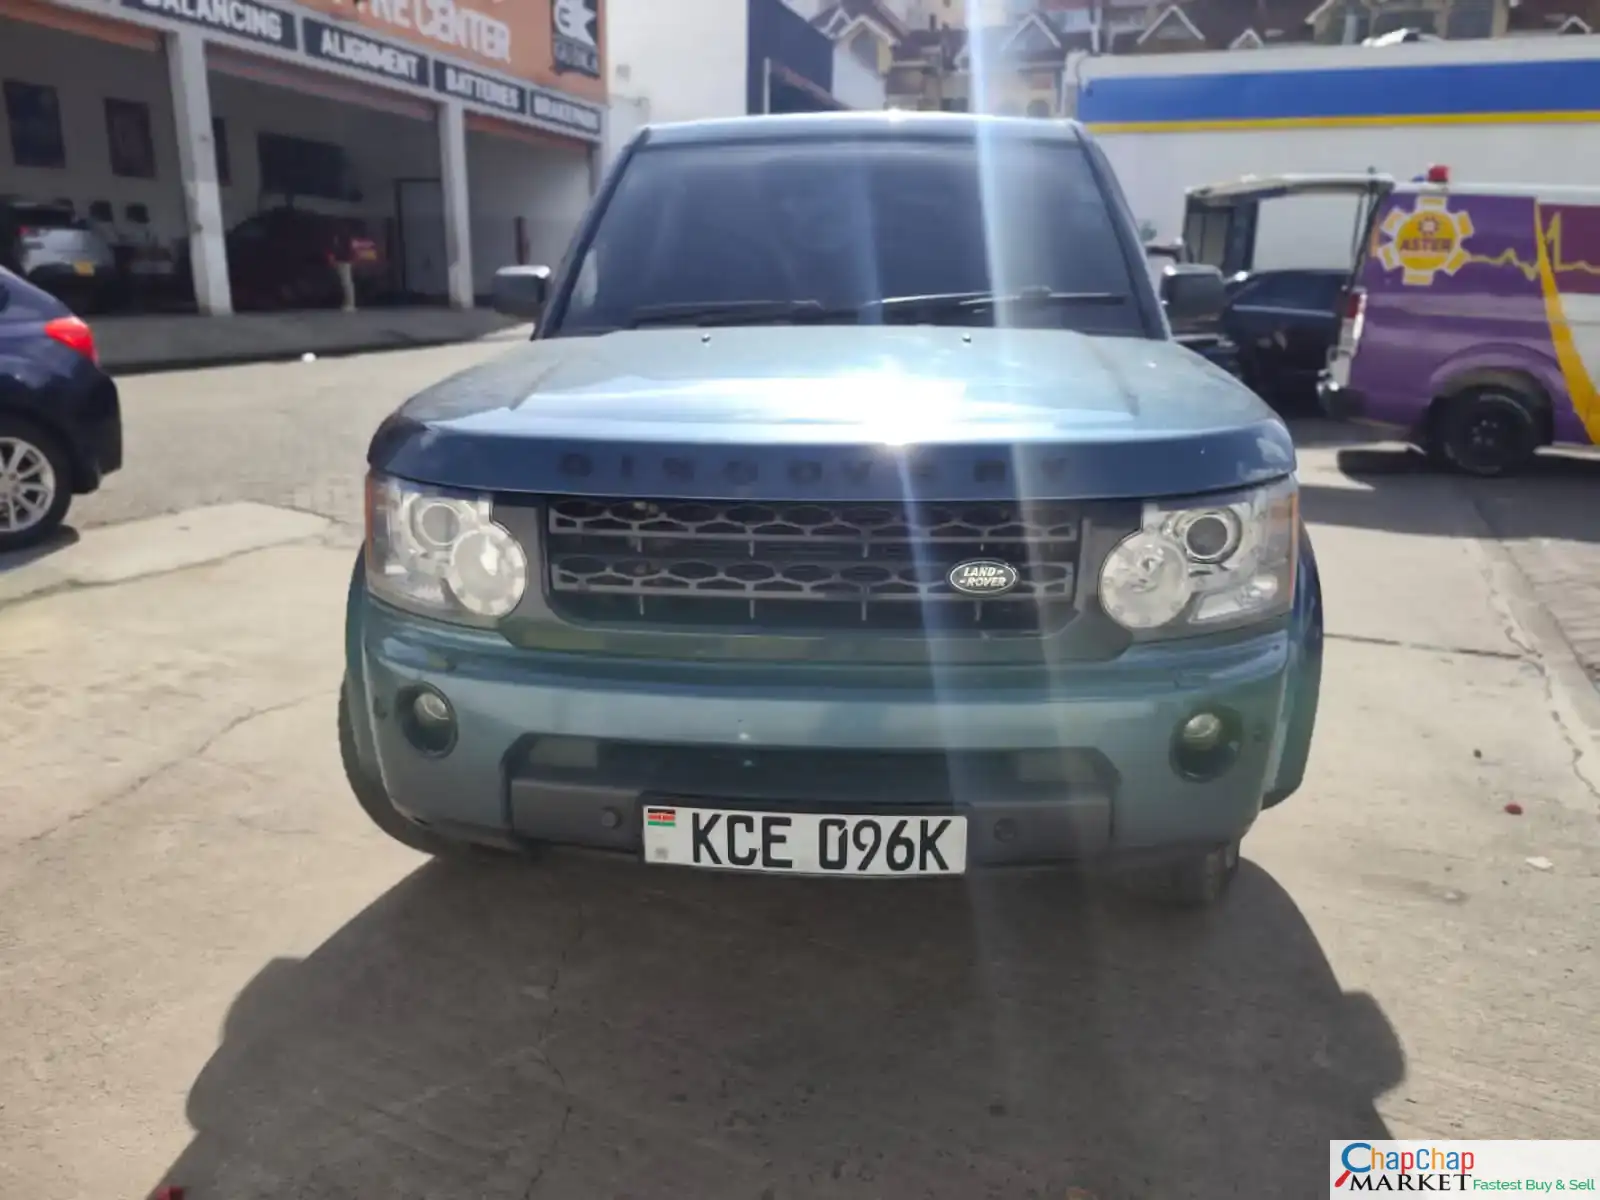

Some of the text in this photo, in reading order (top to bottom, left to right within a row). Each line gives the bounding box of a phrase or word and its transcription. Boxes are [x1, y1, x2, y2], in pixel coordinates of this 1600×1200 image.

[142, 0, 282, 41] ALANCING
[414, 0, 511, 63] CENTER
[321, 28, 419, 79] ALIGNMENT
[1399, 237, 1452, 254] ASTER
[692, 812, 952, 873] KCE 096K
